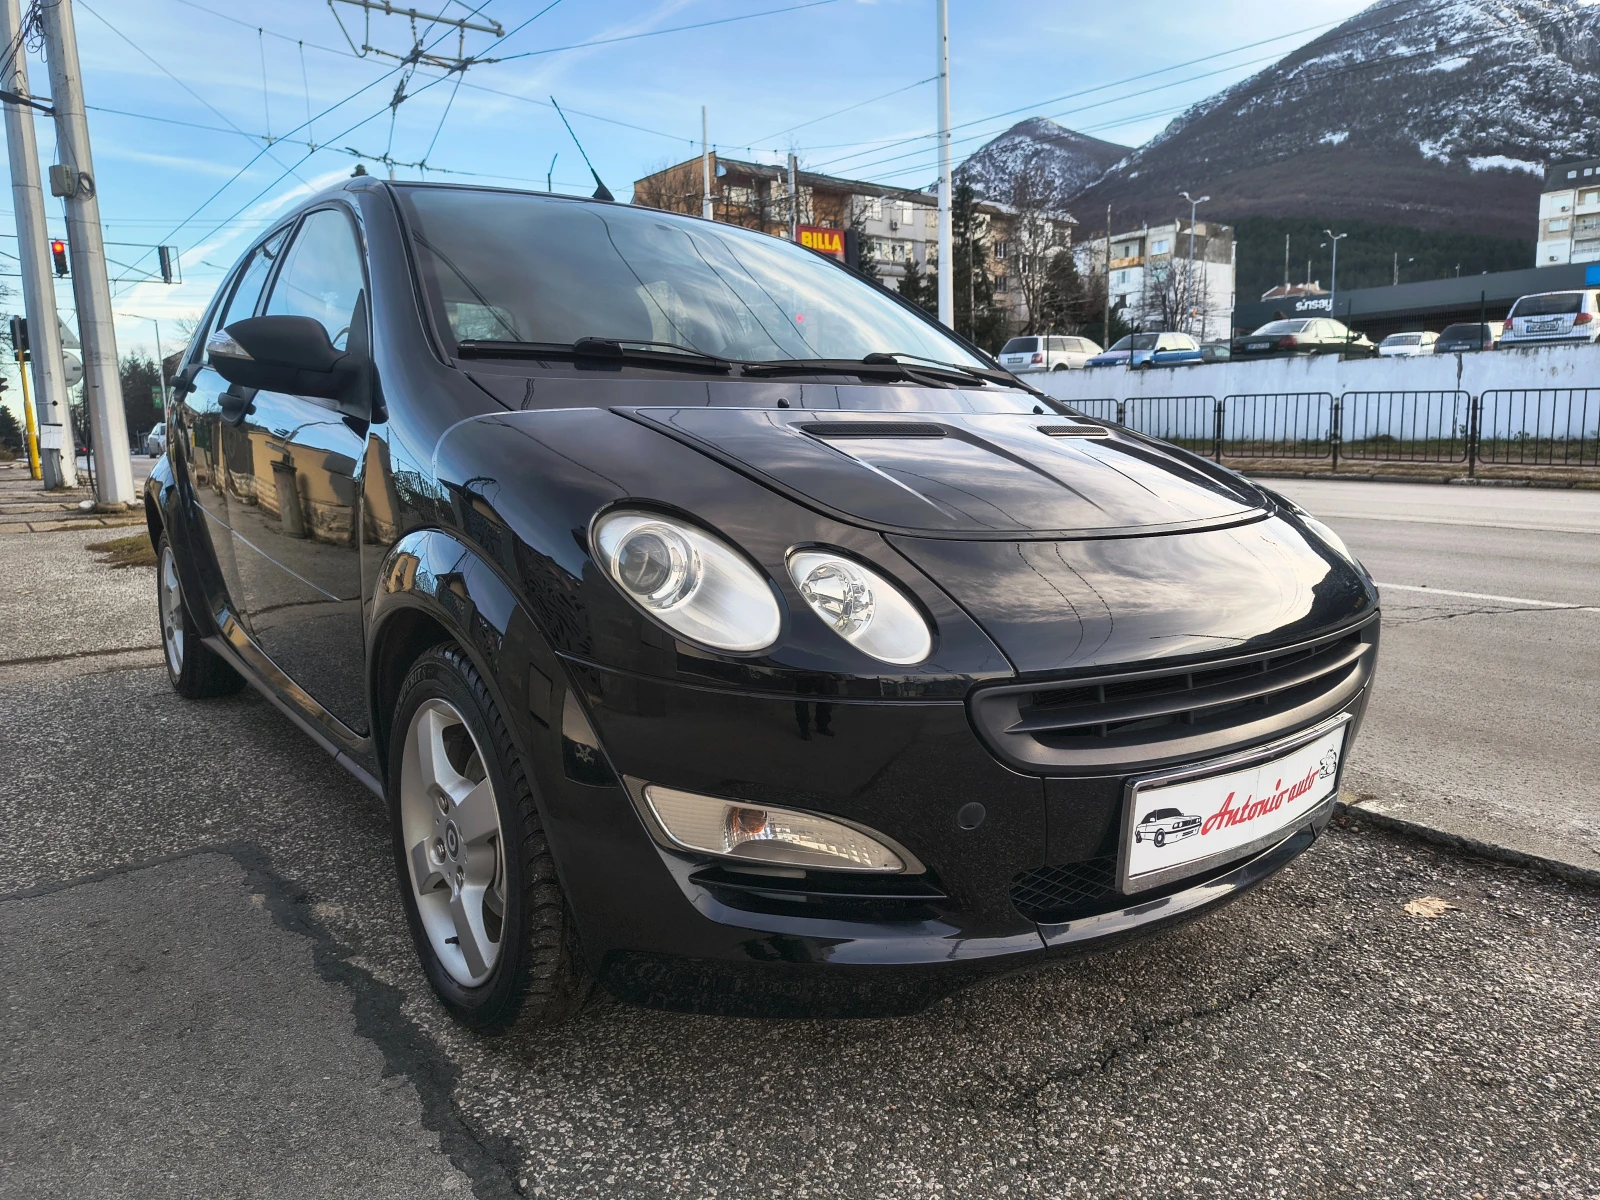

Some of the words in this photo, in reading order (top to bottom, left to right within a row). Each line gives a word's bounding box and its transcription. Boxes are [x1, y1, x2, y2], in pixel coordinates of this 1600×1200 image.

[801, 231, 842, 251] BILLA
[1295, 298, 1333, 311] sinsay
[1201, 779, 1289, 835] Antonio
[1287, 766, 1320, 803] auto
